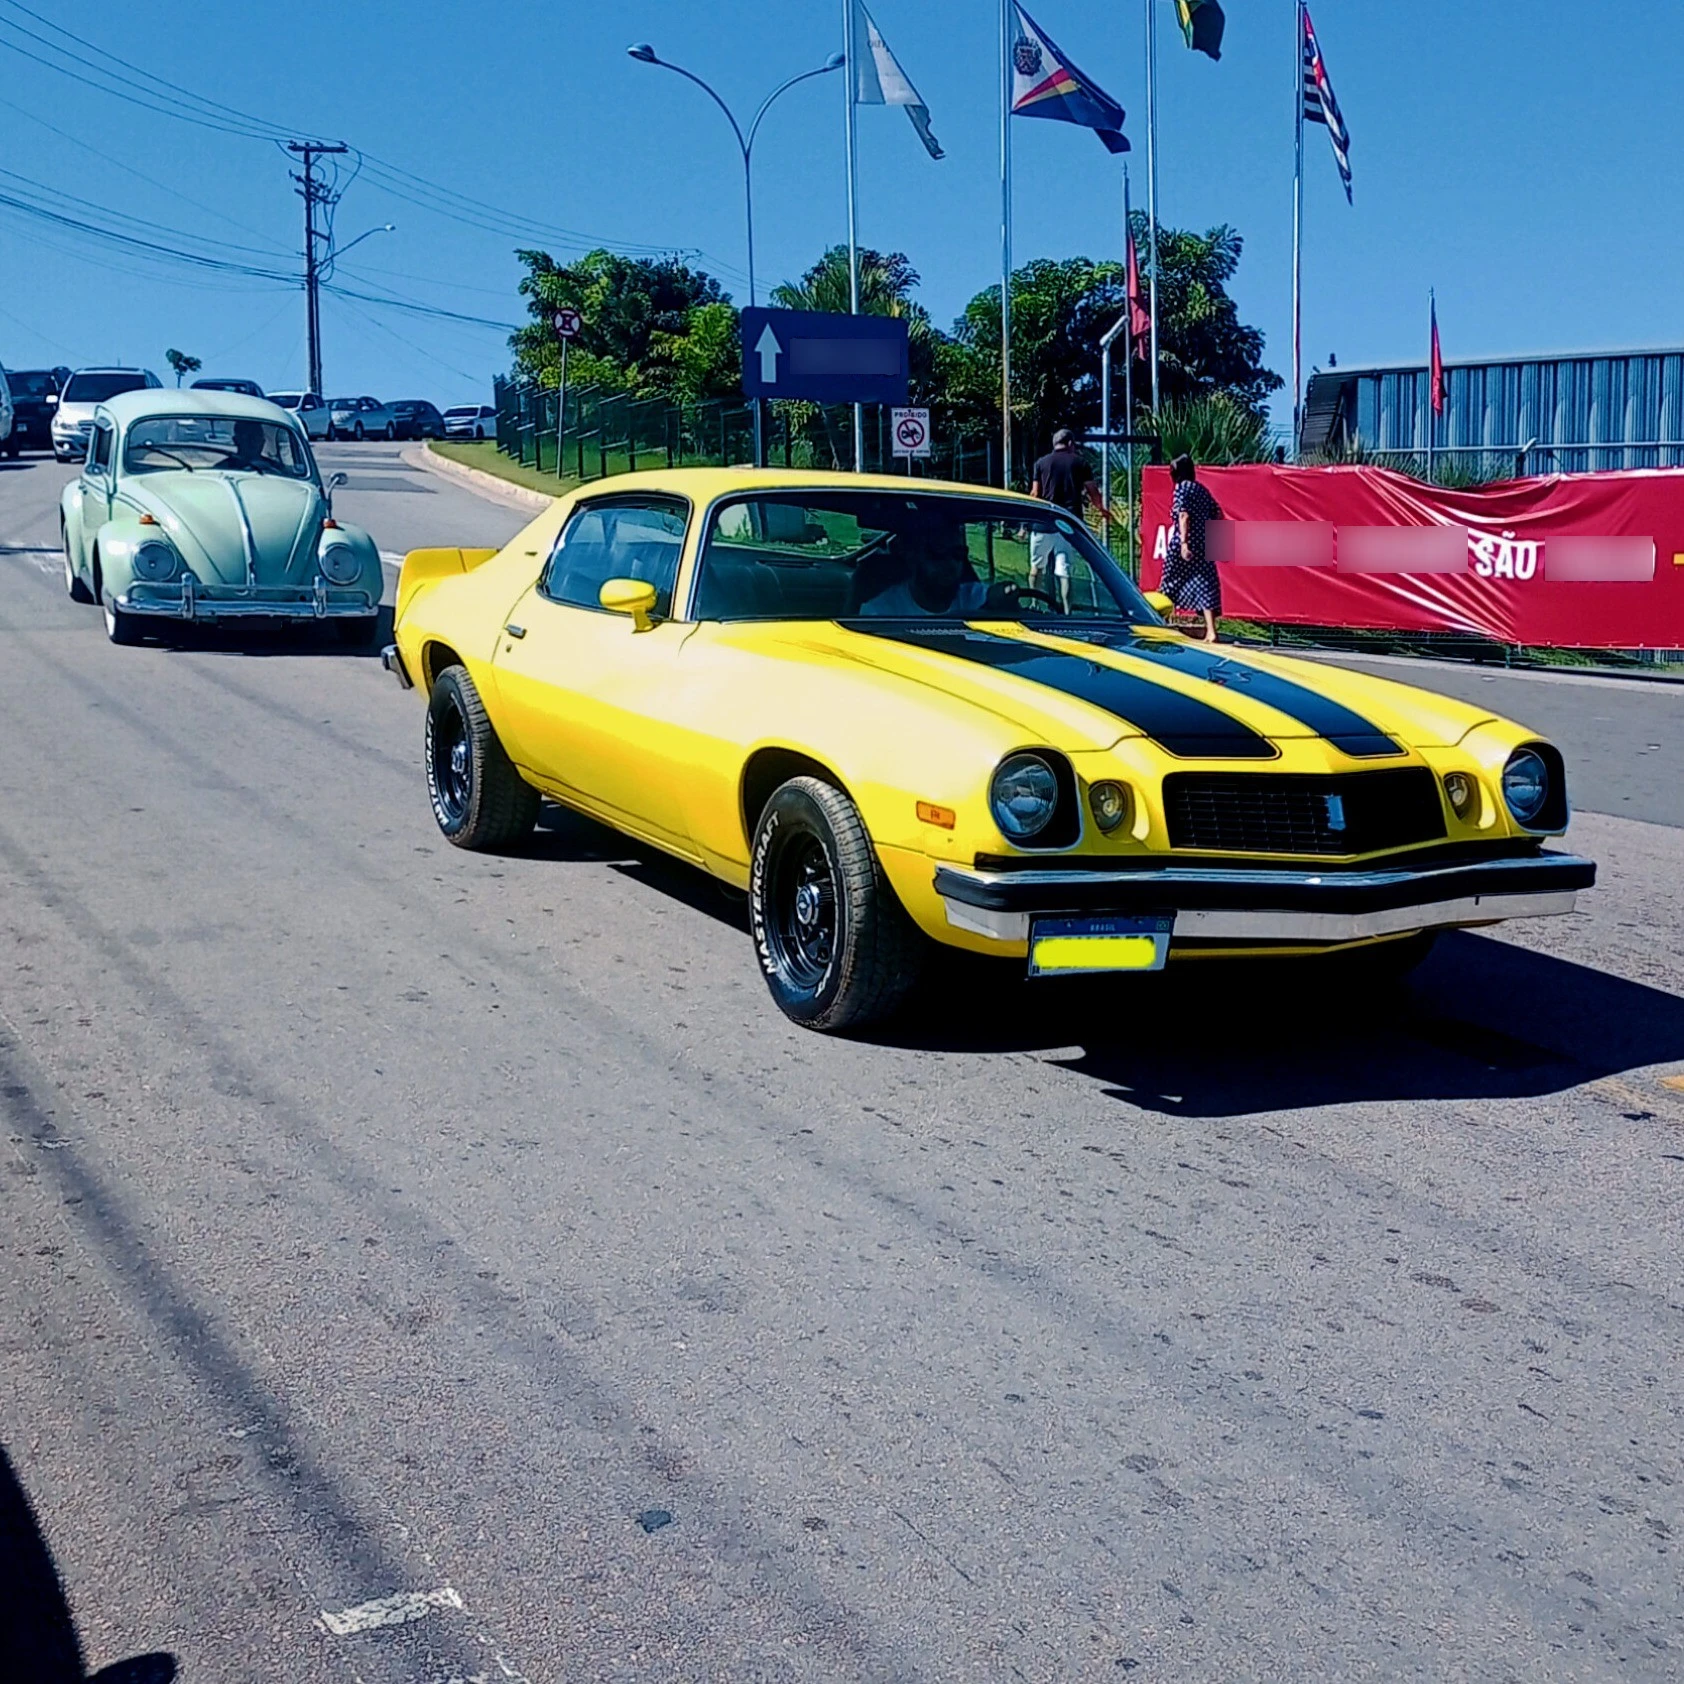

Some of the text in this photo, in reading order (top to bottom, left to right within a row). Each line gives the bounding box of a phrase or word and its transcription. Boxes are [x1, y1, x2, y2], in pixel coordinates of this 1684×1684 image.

[1475, 531, 1537, 580] SÃO
[426, 711, 449, 826] MASTERCRAFT
[752, 811, 779, 974] MASTERCRAFT
